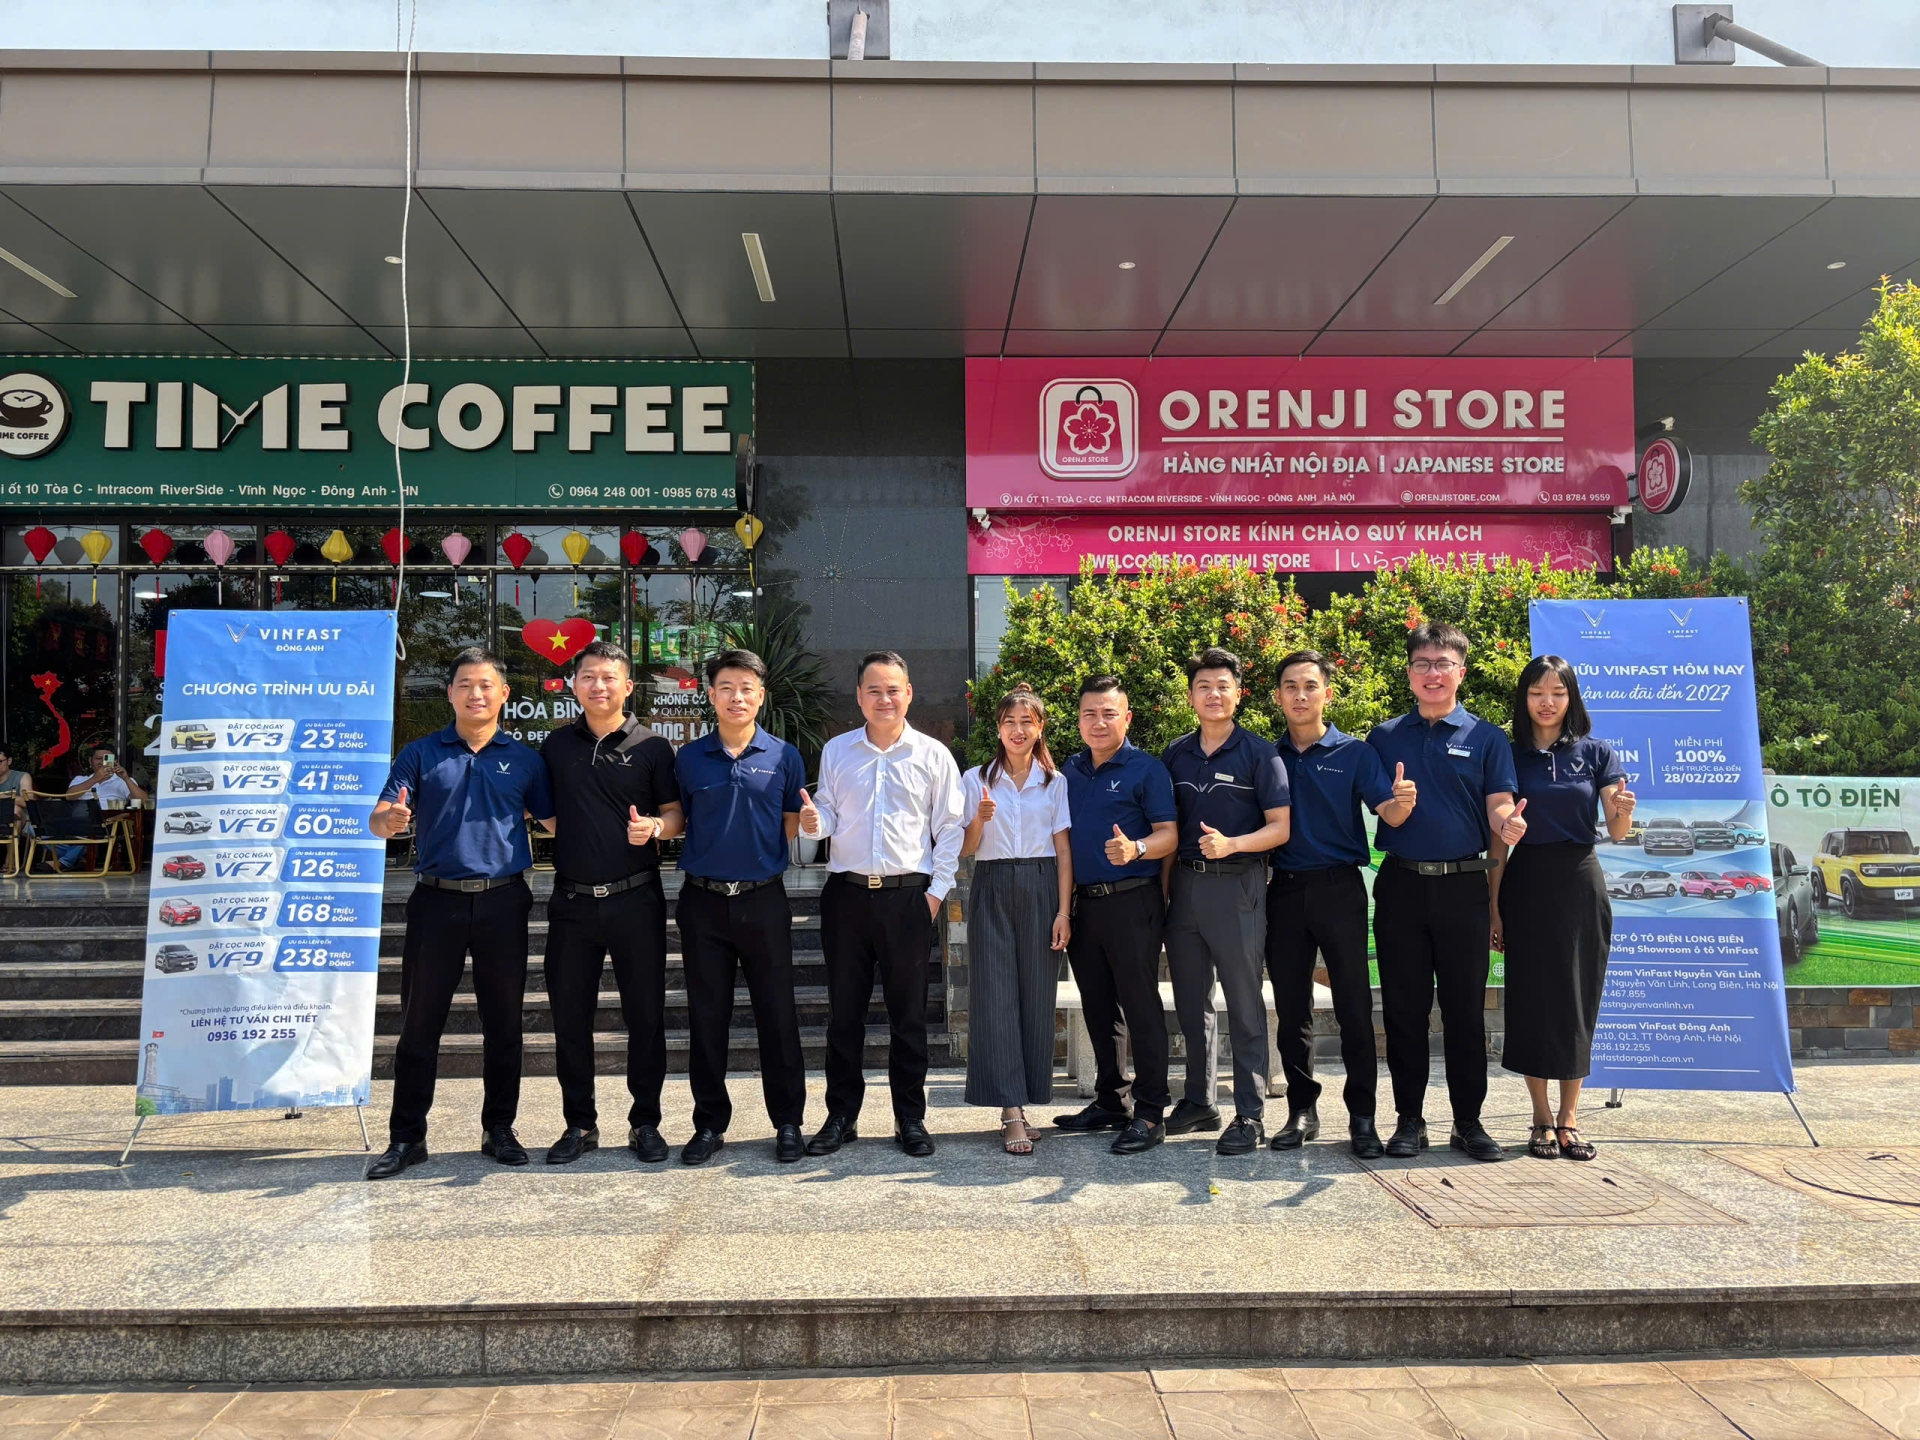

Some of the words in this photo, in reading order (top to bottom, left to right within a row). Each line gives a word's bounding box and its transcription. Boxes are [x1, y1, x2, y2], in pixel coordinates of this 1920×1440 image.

[90, 381, 349, 450] TIME
[377, 382, 731, 452] COFFEE
[1159, 389, 1367, 431] ORENJI
[1393, 389, 1565, 430] STORE
[1163, 451, 1227, 474] HÀNG
[1231, 452, 1284, 478] NHẬT
[1289, 452, 1328, 479] NỘI
[1333, 456, 1370, 480] ĐỊA
[1394, 456, 1494, 474] JAPANESE
[1501, 456, 1565, 474] STORE
[26, 483, 39, 495] 10
[44, 483, 68, 495] Tòa
[73, 483, 83, 495] C
[97, 484, 153, 495] Intracom
[160, 484, 224, 496] RiverSide
[238, 484, 266, 496] Vĩnh
[273, 484, 307, 500] Ngọc
[321, 484, 355, 499] Đông
[361, 485, 387, 497] Anh
[401, 486, 419, 497] HN
[569, 486, 599, 498] 0964
[603, 486, 626, 498] 248
[630, 486, 651, 498] 001
[662, 487, 692, 498] 0985
[695, 487, 718, 498] 678
[1014, 495, 1023, 503] KI
[1041, 495, 1049, 503] 11
[1089, 495, 1102, 503] CC
[1106, 495, 1155, 503] INTRACOM
[1157, 495, 1203, 503] RIVERSIDE
[1210, 493, 1232, 503] VĨNH
[1234, 495, 1260, 504] NGỌC
[1297, 494, 1317, 502] ANH
[1323, 492, 1337, 502] HÀ
[1339, 493, 1355, 503] NỘI
[1414, 494, 1500, 502] ORENJISTORE.COM
[1108, 526, 1176, 542] ORENJI
[1183, 526, 1241, 542] STORE
[1249, 521, 1294, 541] KÍNH
[1302, 521, 1359, 541] CHÀO
[1366, 521, 1406, 541] QUÝ
[1414, 521, 1482, 541] KHÁCH
[1262, 553, 1310, 568] STORE
[259, 628, 342, 640] VINFAST
[1603, 665, 1668, 676] VINFAST
[1673, 663, 1709, 675] HÔM
[1713, 665, 1745, 675] NAY
[182, 682, 257, 696] CHƯƠNG
[262, 680, 313, 696] TRÌNH
[317, 682, 343, 696] ƯU
[346, 680, 375, 696] ĐÃI
[1656, 684, 1684, 700] đến
[1685, 684, 1731, 702] 2027
[653, 692, 689, 706] KHÔNG
[692, 690, 708, 705] CÓ
[504, 695, 549, 719] HÒA
[661, 706, 683, 718] QUÝ
[245, 723, 262, 731] CỌC
[300, 729, 336, 749] 23
[339, 732, 364, 740] TRIỆU
[1674, 736, 1702, 747] MIỄN
[1704, 737, 1723, 747] PHÍ
[1675, 750, 1727, 763] 100%
[241, 765, 258, 773] CỌC
[1671, 764, 1683, 772] PHÍ
[297, 771, 328, 791] 41
[334, 774, 359, 783] TRIỆU
[1664, 773, 1741, 784] 28/02/2027
[1770, 783, 1789, 808] Ô
[1796, 783, 1832, 808] TÔ
[1840, 783, 1900, 812] ĐIỆN
[293, 814, 333, 835] 60
[334, 817, 359, 826] TRIỆU
[291, 858, 334, 878] 126
[335, 863, 357, 871] TRIỆU
[230, 897, 247, 905] CỌC
[287, 903, 331, 922] 168
[332, 907, 354, 915] TRIỆU
[1640, 933, 1654, 942] TÔ
[1657, 933, 1683, 944] ĐIỆN
[1685, 935, 1715, 943] LONG
[1718, 934, 1744, 943] BIÊN
[226, 942, 243, 950] CỌC
[1637, 945, 1691, 954] Showroom
[1717, 946, 1759, 955] VinFast
[279, 948, 328, 967] 238
[329, 951, 351, 959] TRIỆU
[1634, 969, 1672, 977] VinFast
[1674, 968, 1712, 979] Nguyễn
[1714, 970, 1736, 978] Văn
[1738, 970, 1761, 978] Linh
[1611, 978, 1646, 989] Nguyễn
[1648, 980, 1666, 988] Văn
[1692, 981, 1717, 991] Long
[1746, 981, 1761, 989] Hà
[1763, 981, 1779, 991] Nội
[191, 1017, 212, 1028] LIÊN
[214, 1016, 227, 1027] HỆ
[229, 1015, 245, 1025] TƯ
[246, 1012, 269, 1024] VẤN
[272, 1015, 291, 1023] CHI
[294, 1013, 318, 1023] TIẾT
[1639, 1022, 1677, 1031] VinFast
[1679, 1022, 1707, 1033] Đông
[1709, 1023, 1731, 1032] Anh
[207, 1031, 237, 1042] 0936
[242, 1030, 266, 1040] 192
[271, 1029, 296, 1039] 255
[1641, 1032, 1653, 1041] TT
[1655, 1033, 1681, 1043] Đông
[1708, 1033, 1722, 1042] Hà
[1724, 1034, 1742, 1043] Nội
